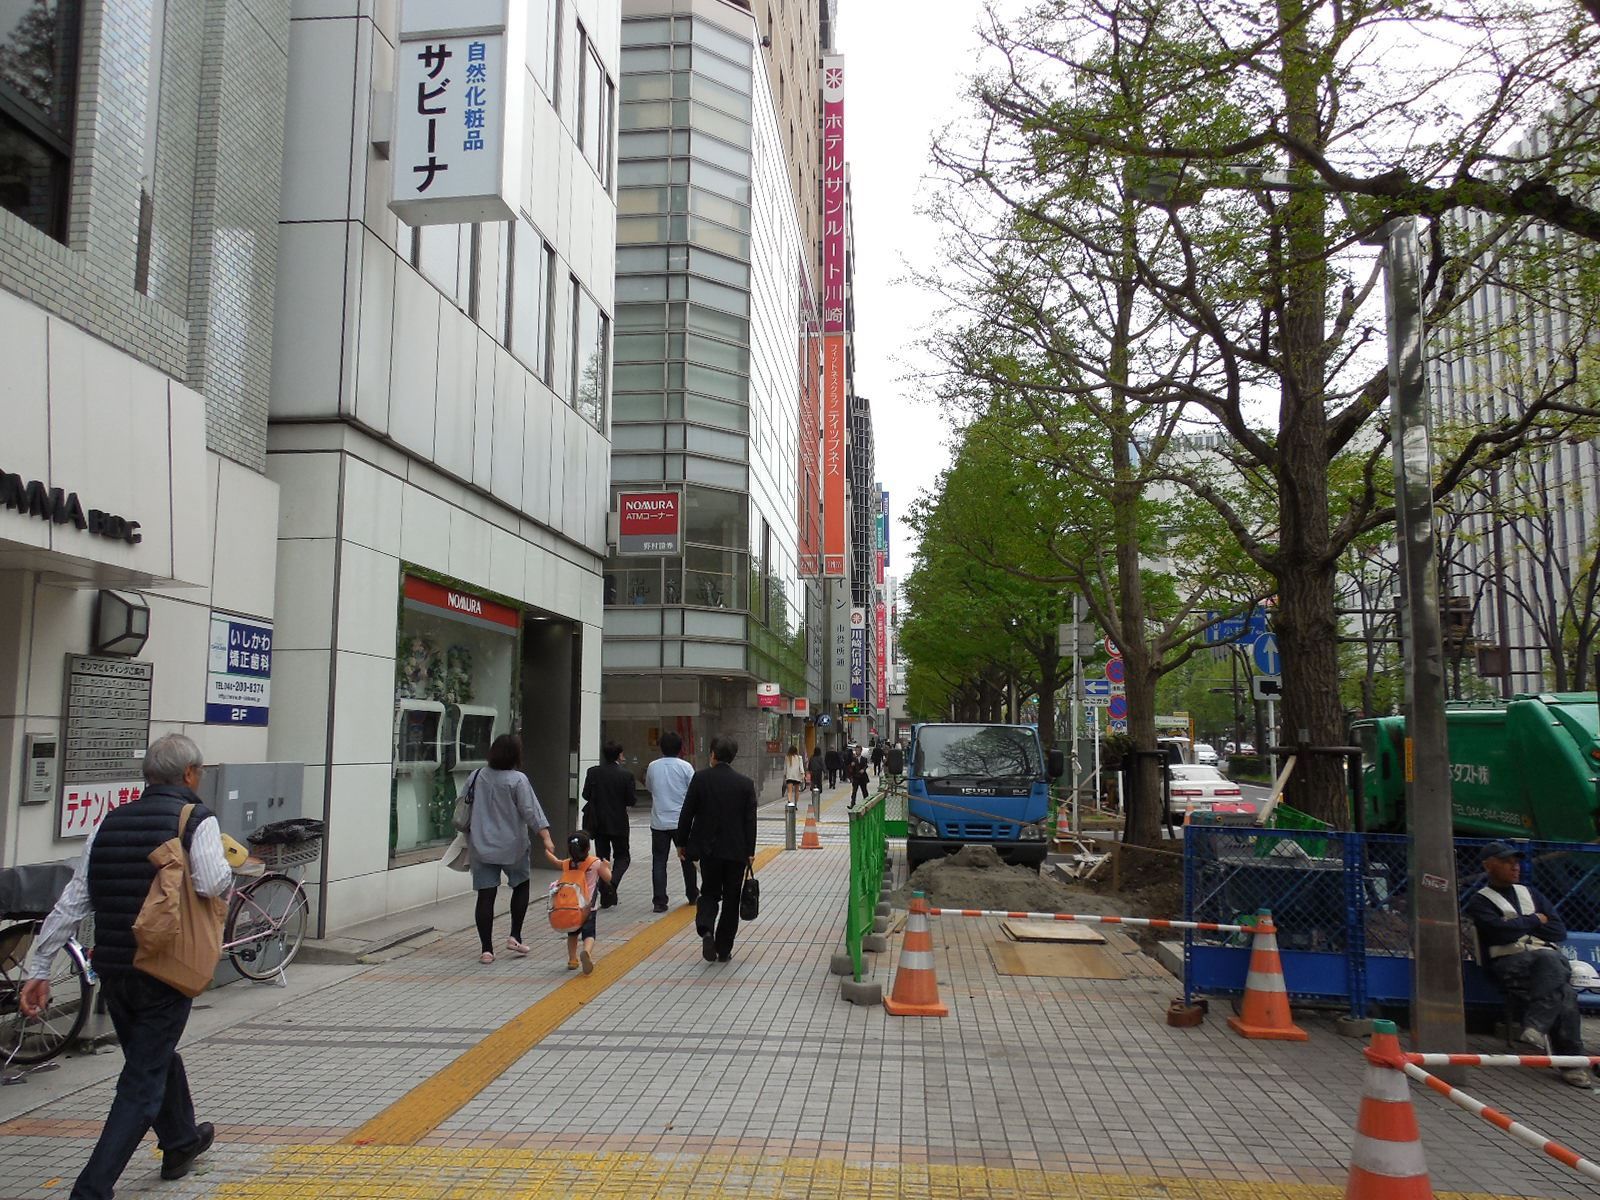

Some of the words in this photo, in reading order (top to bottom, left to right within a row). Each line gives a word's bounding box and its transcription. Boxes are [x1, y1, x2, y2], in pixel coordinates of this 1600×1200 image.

[463, 41, 487, 152] 自然化粧品
[413, 44, 452, 193] サビーナ
[825, 113, 843, 322] ホテルサンルート川崎
[625, 500, 674, 510] NOMURA
[626, 512, 674, 520] ATMコーナー
[447, 592, 482, 614] NOMURA
[230, 629, 270, 651] いしかわ
[229, 649, 270, 671] 矯正歯科
[851, 630, 862, 686] 川崎信用金庫
[1083, 697, 1109, 707] ここから
[231, 708, 248, 721] 2F
[961, 788, 996, 796] ISUZU
